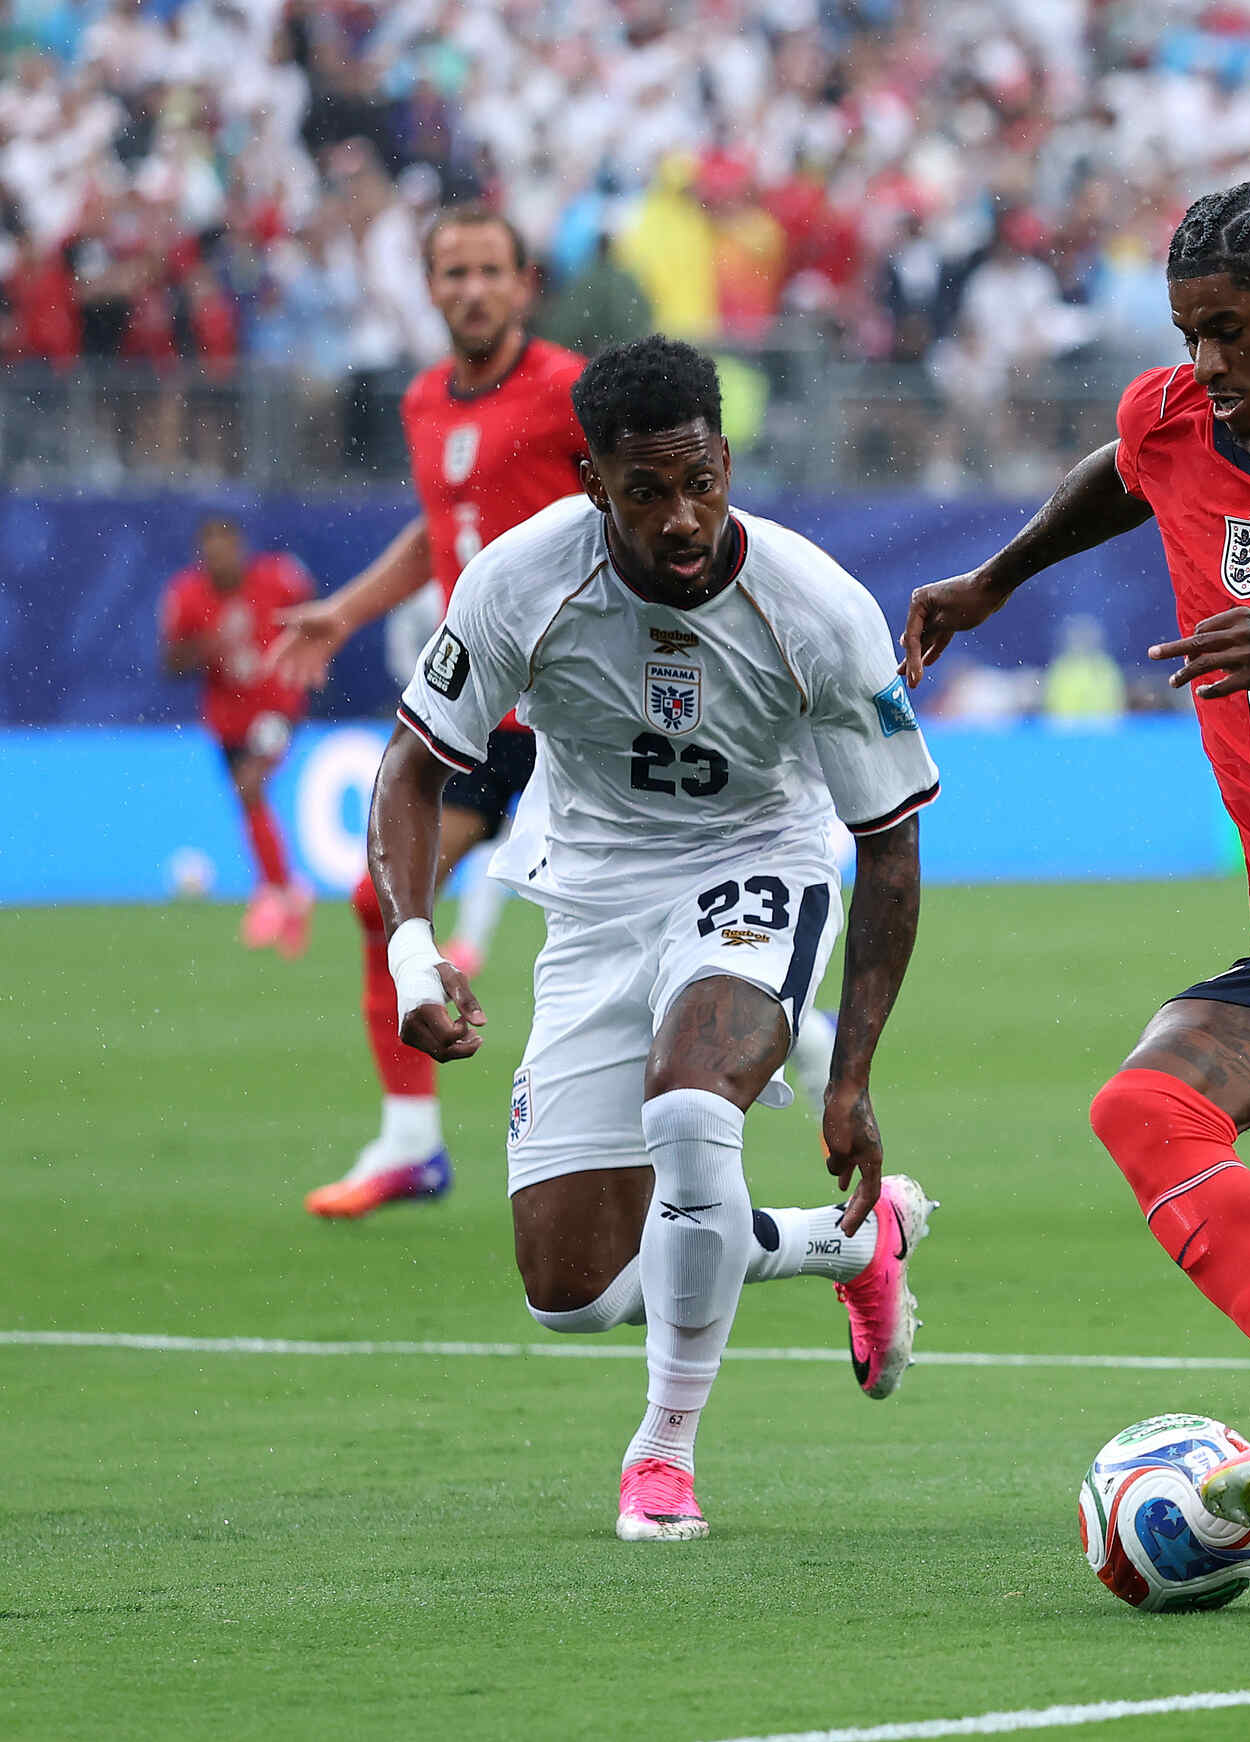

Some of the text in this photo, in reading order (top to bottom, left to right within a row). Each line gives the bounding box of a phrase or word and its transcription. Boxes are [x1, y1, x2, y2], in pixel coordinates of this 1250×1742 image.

[648, 628, 699, 646] Reebok
[651, 667, 695, 680] PANAMA
[631, 732, 729, 797] 23
[697, 875, 790, 938] 23
[721, 929, 770, 943] Reebok
[806, 1239, 841, 1255] OWER
[669, 1414, 683, 1426] 62
